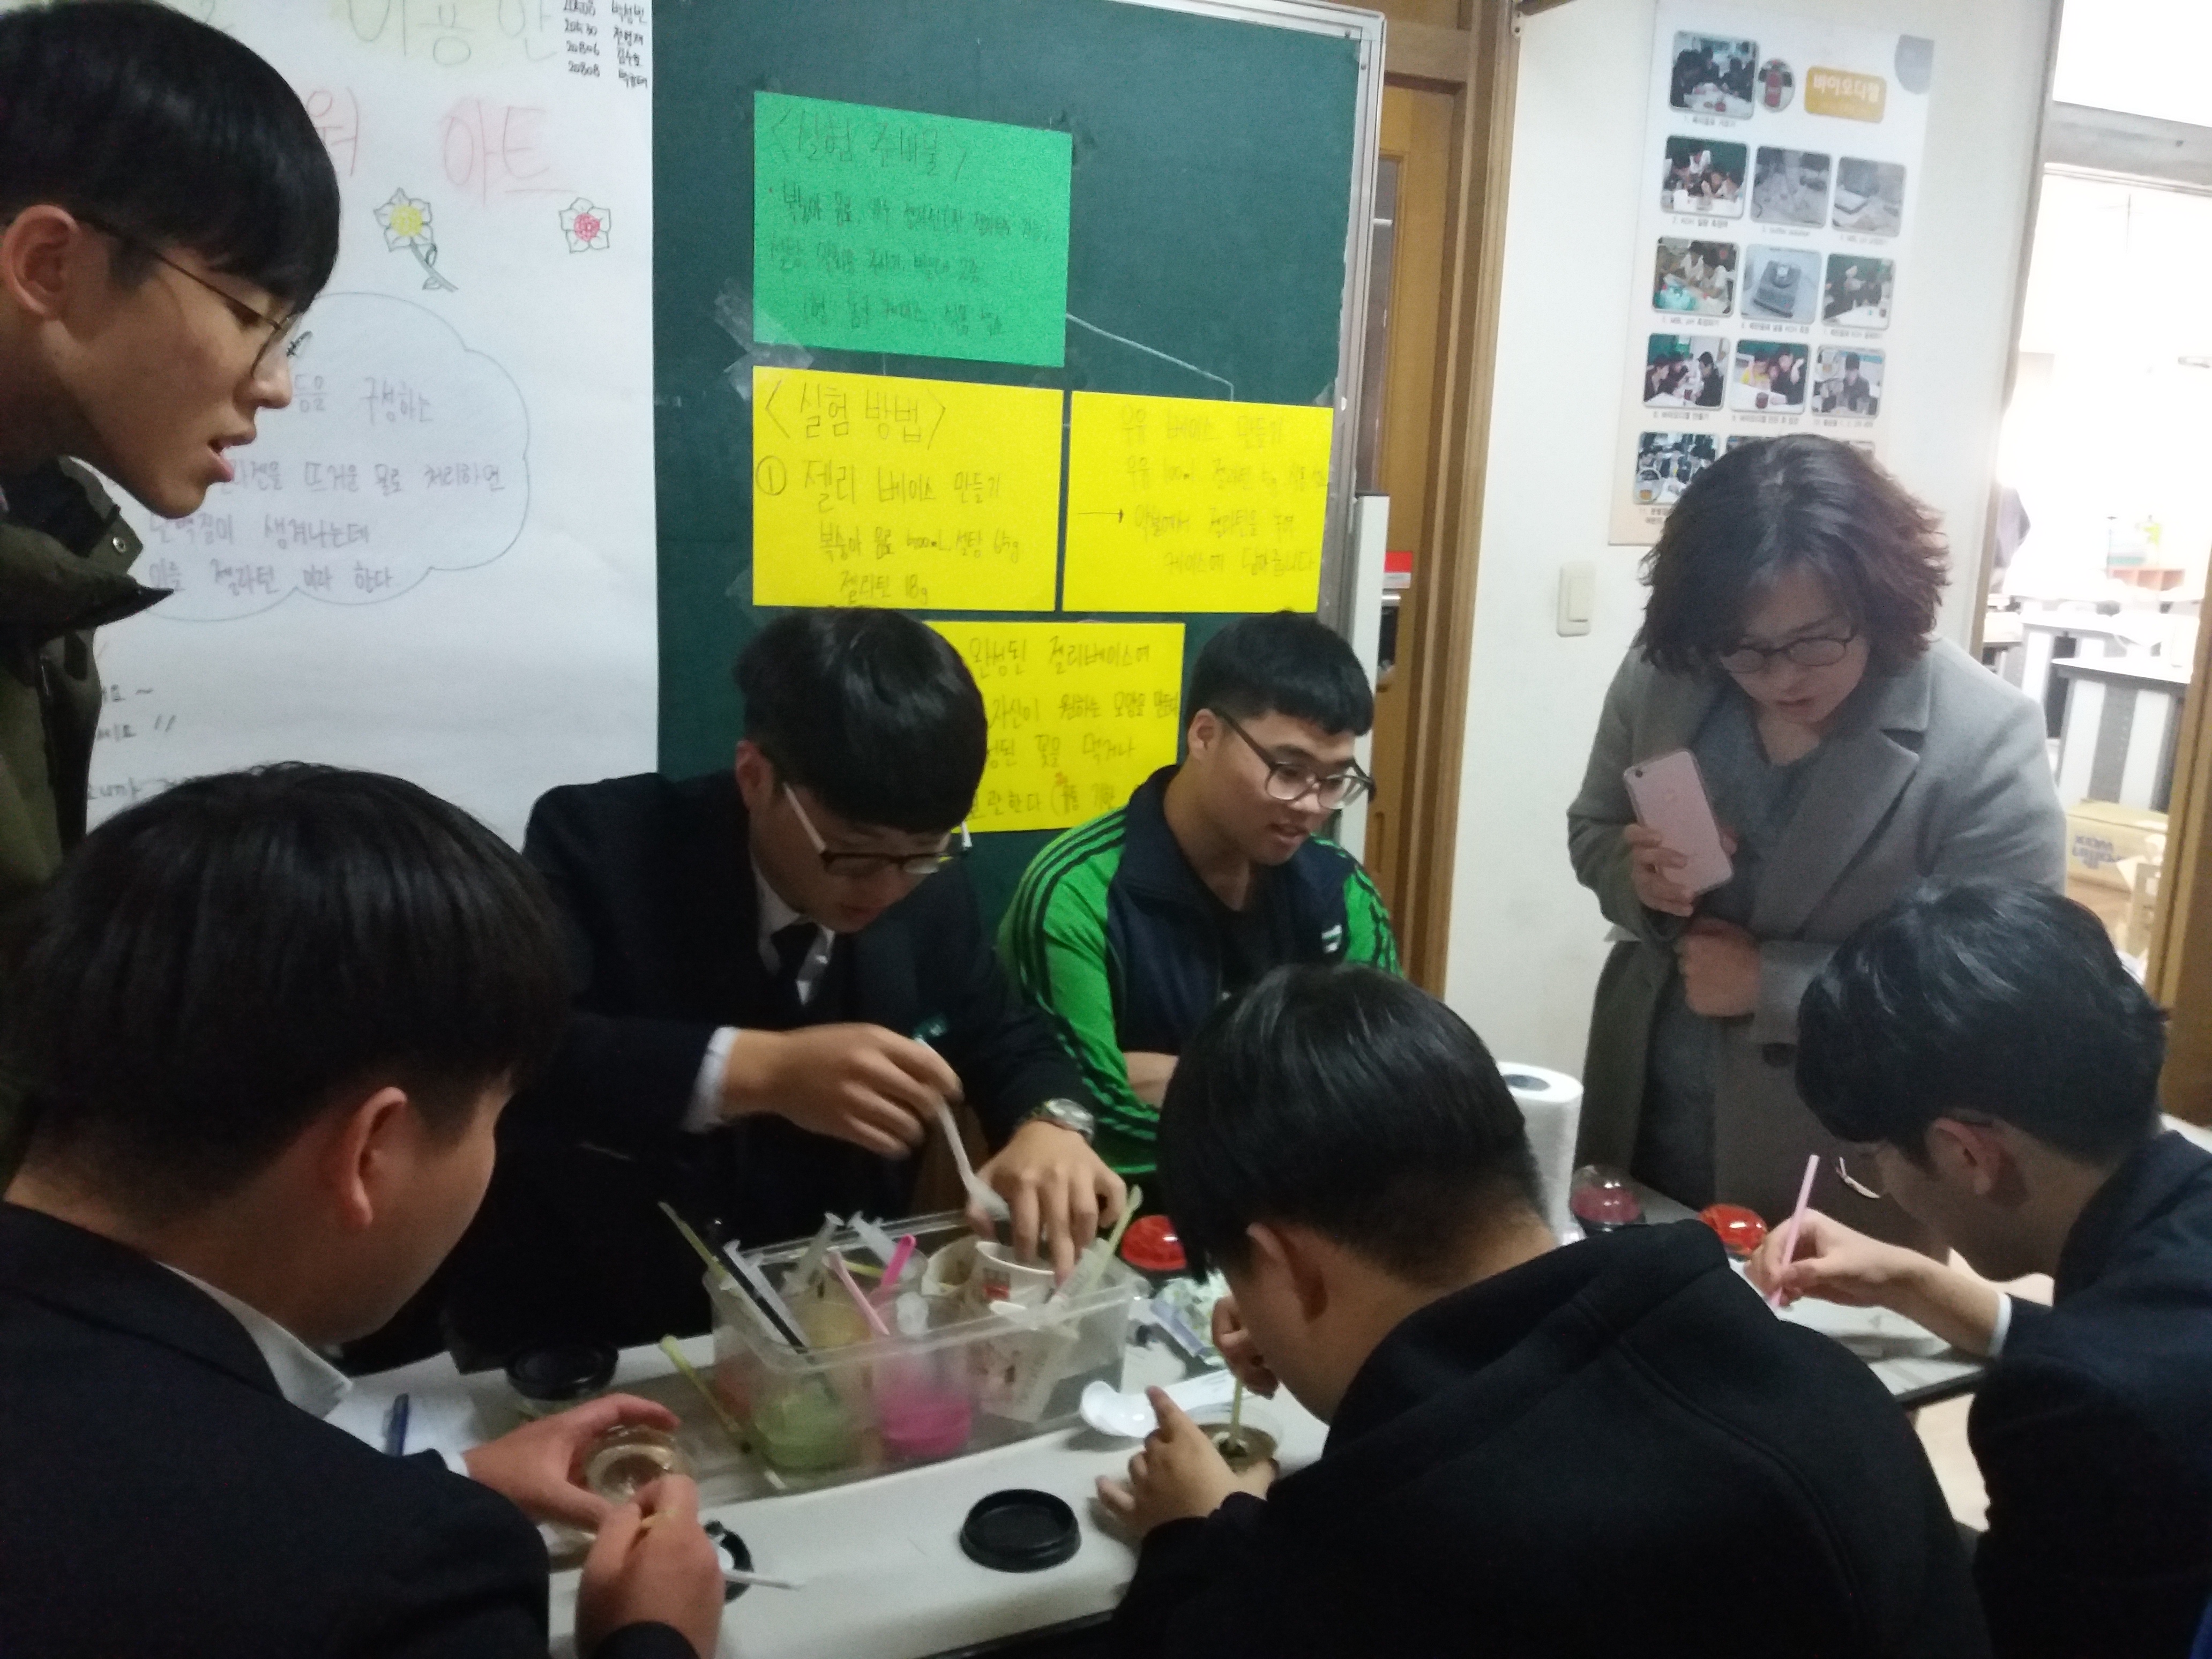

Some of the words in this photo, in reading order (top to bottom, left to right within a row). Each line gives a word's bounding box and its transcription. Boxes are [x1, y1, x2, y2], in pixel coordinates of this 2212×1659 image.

[444, 100, 577, 201] 아트
[360, 376, 434, 426] 구성하는
[765, 380, 848, 439] <실험
[865, 387, 946, 450] 방법>
[304, 461, 359, 494] 뜨거운
[424, 461, 506, 493] 처리하면
[804, 459, 856, 513] 젤리
[877, 466, 936, 503] 베이스
[954, 470, 1002, 504] 만들기
[265, 514, 370, 550] 생겨나는데
[819, 521, 862, 563] 복숭아
[354, 560, 394, 593] 한다
[969, 637, 1027, 679] 완성된
[1058, 693, 1102, 720] 원하는
[1083, 732, 1137, 765] 먹거나
